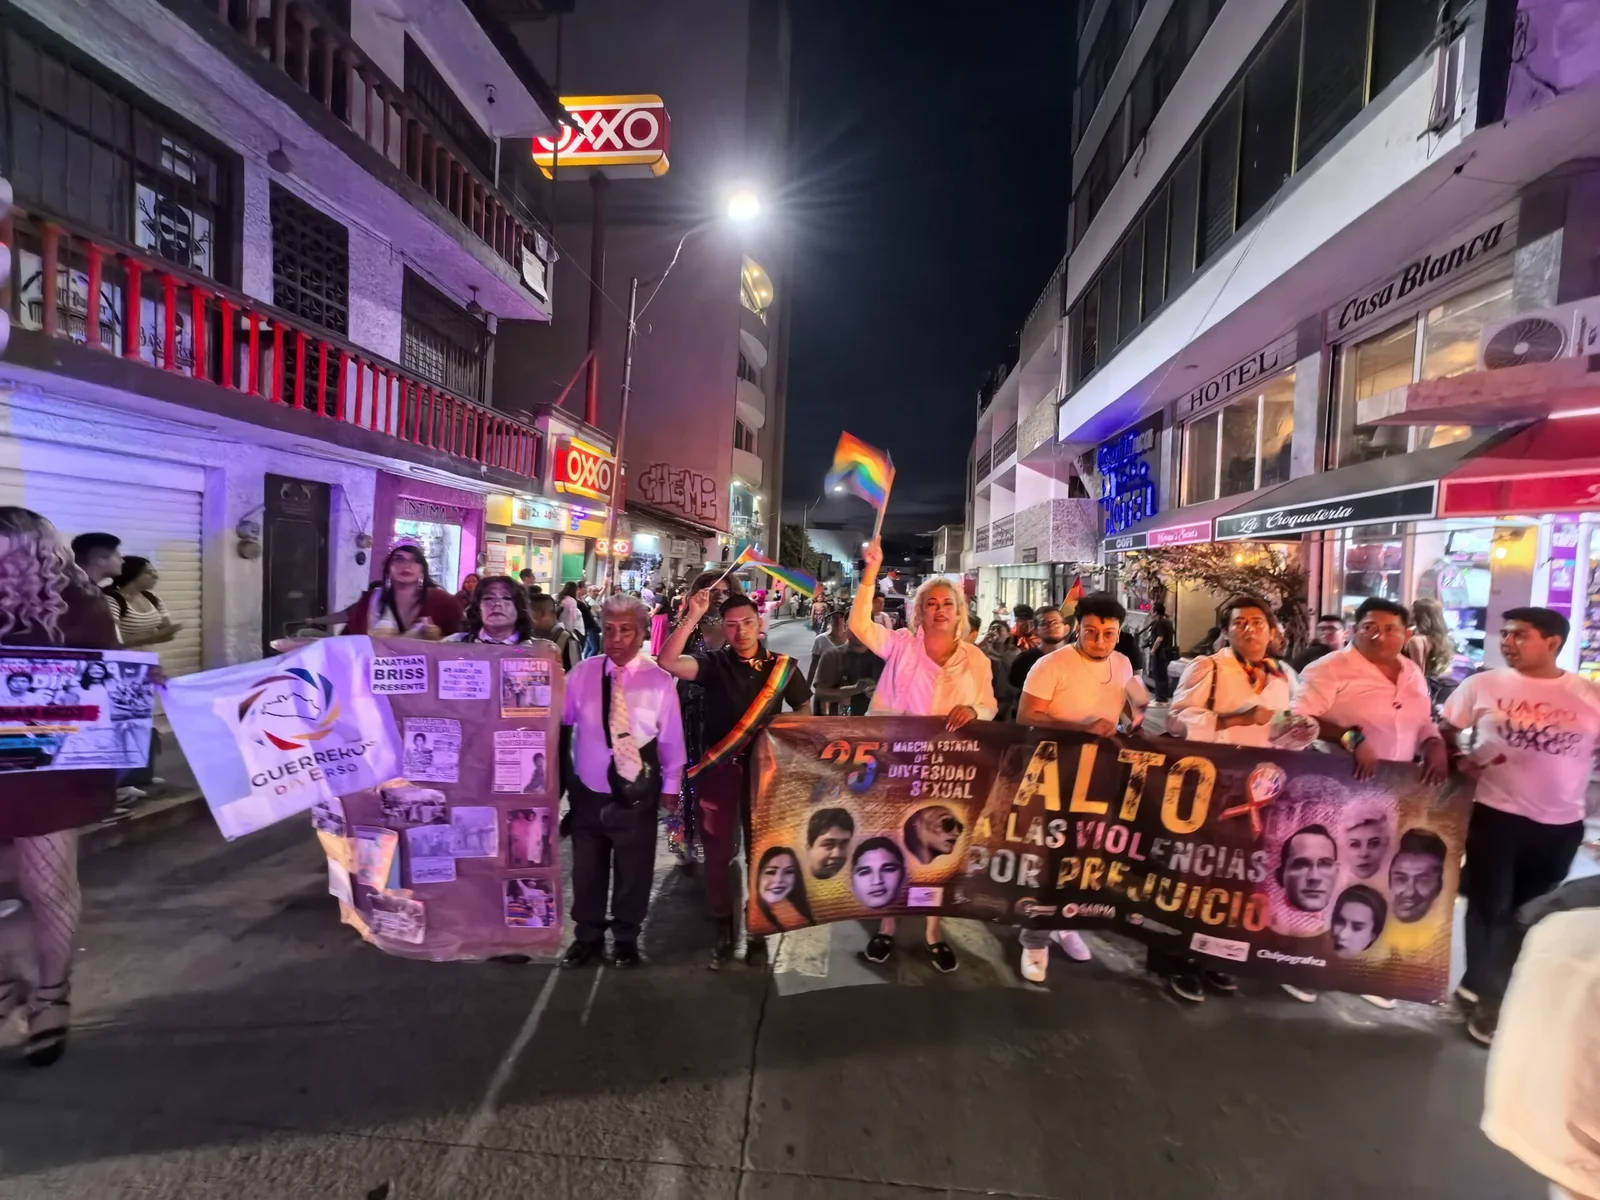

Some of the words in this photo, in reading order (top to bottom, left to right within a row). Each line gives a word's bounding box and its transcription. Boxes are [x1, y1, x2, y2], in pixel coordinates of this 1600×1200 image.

[1338, 282, 1394, 331] Casa
[1397, 221, 1506, 301] Blanca
[1190, 351, 1279, 411] HOTEL
[567, 450, 611, 491] OXXO
[1238, 518, 1260, 534] La
[373, 668, 425, 681] BRISS
[503, 660, 549, 672] IMPACTO
[372, 682, 426, 692] PRESENTE
[931, 754, 944, 764] LA
[888, 765, 977, 781] DIVERSIDAD
[910, 780, 974, 799] SEXUAL
[1013, 740, 1217, 834] ALTO
[970, 816, 992, 839] A
[1005, 812, 1068, 849] LAS
[1076, 821, 1268, 883] VIOLENCIAS
[965, 845, 1044, 889] POR
[1056, 856, 1270, 932] PREJUICIO
